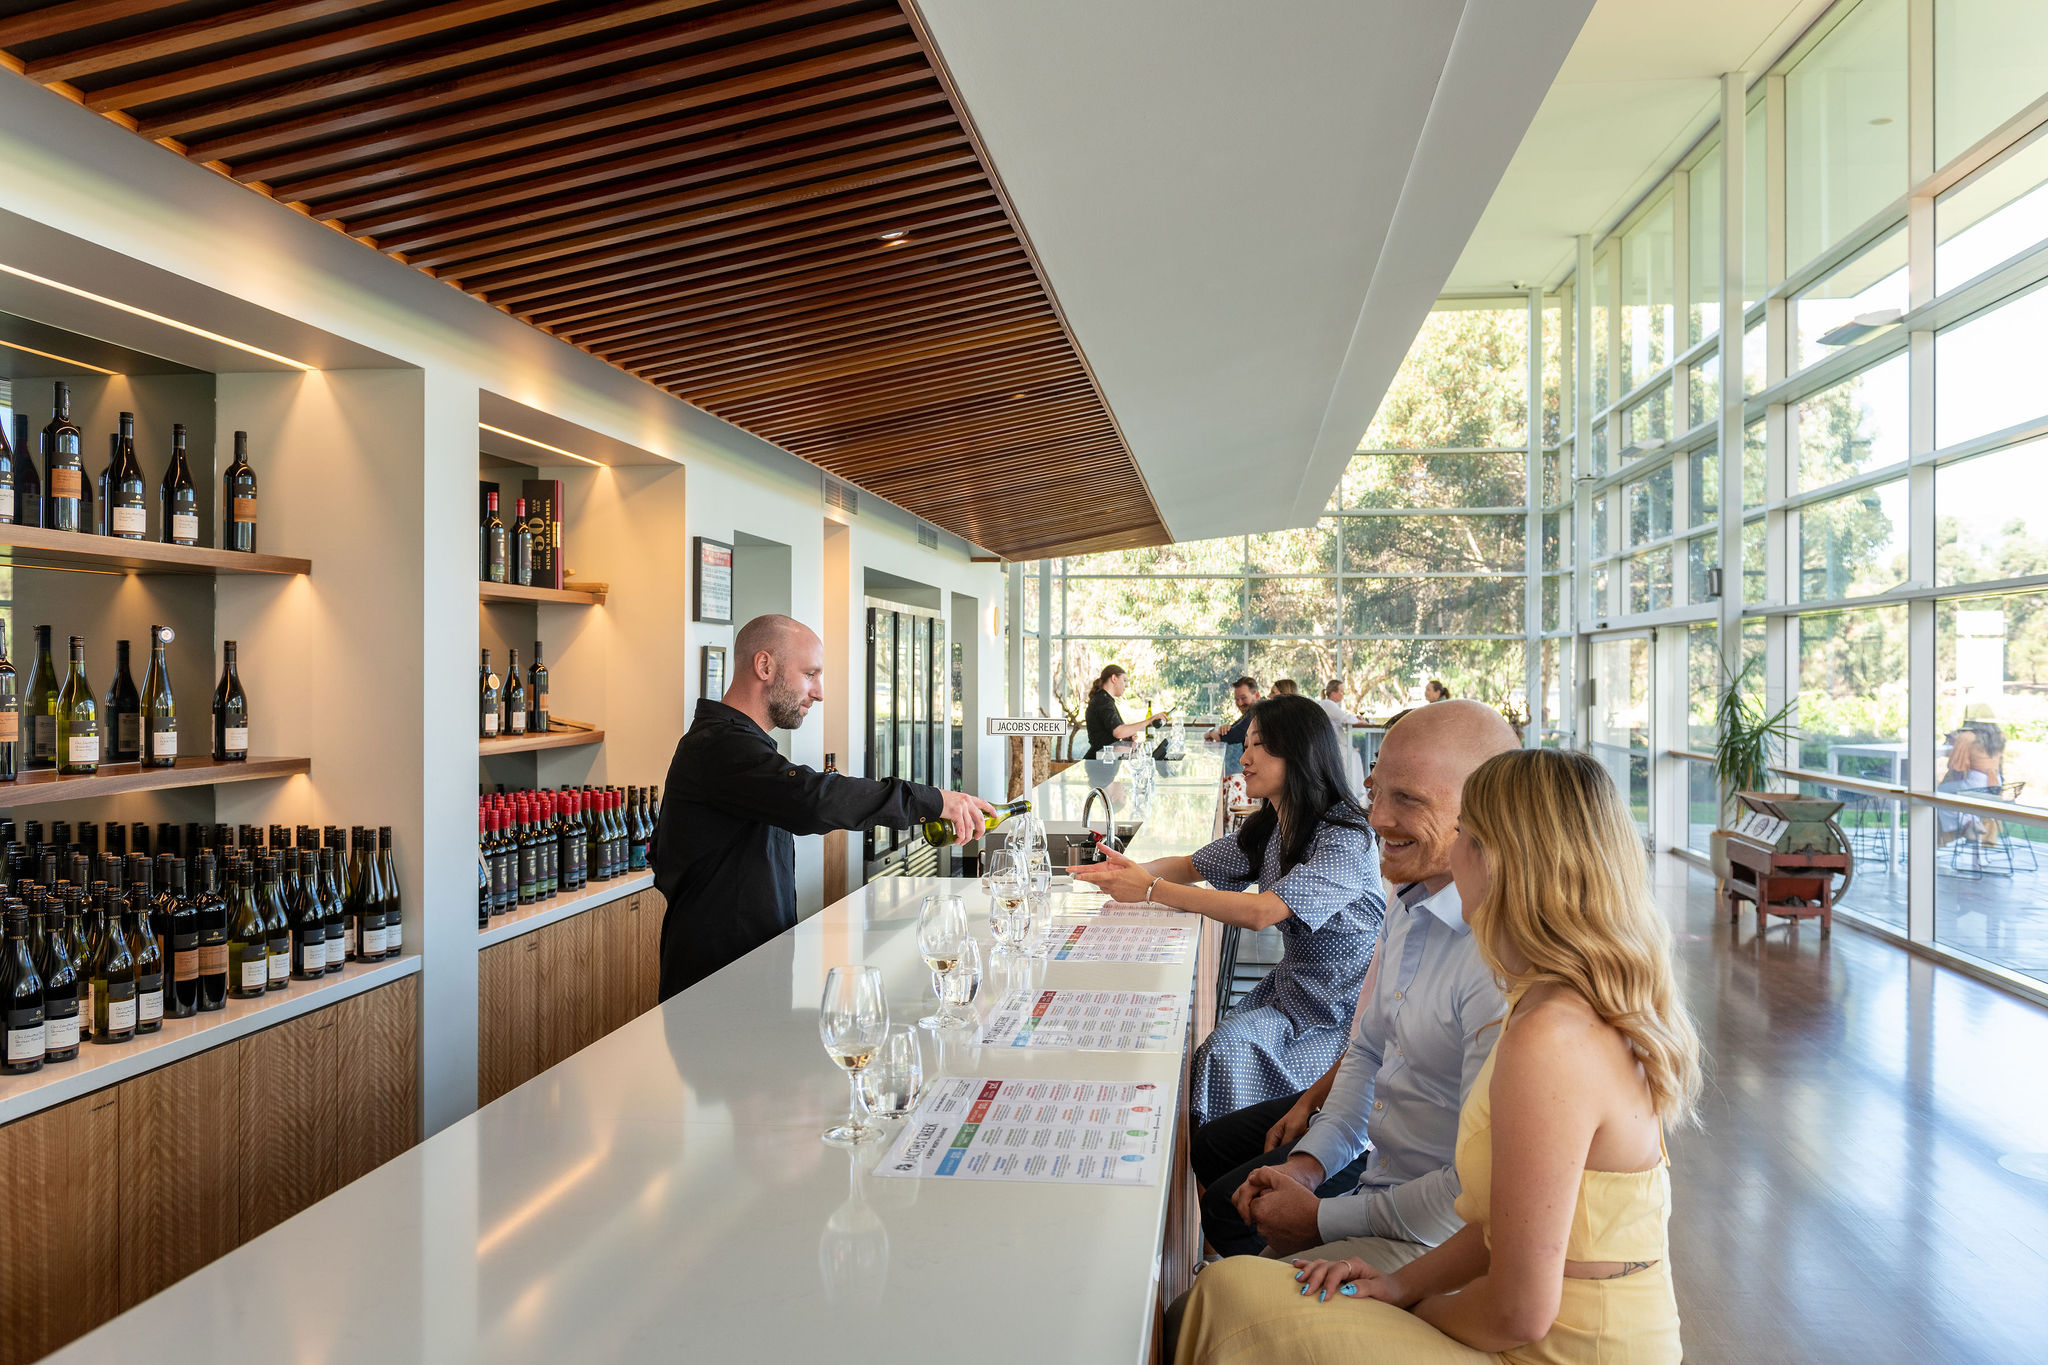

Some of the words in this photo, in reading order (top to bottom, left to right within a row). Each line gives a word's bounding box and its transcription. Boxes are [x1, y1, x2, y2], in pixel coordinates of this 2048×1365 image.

[528, 518, 544, 551] 50
[997, 722, 1031, 732] JACOB'S
[1032, 722, 1061, 732] CREEK
[916, 1122, 940, 1140] CREEK
